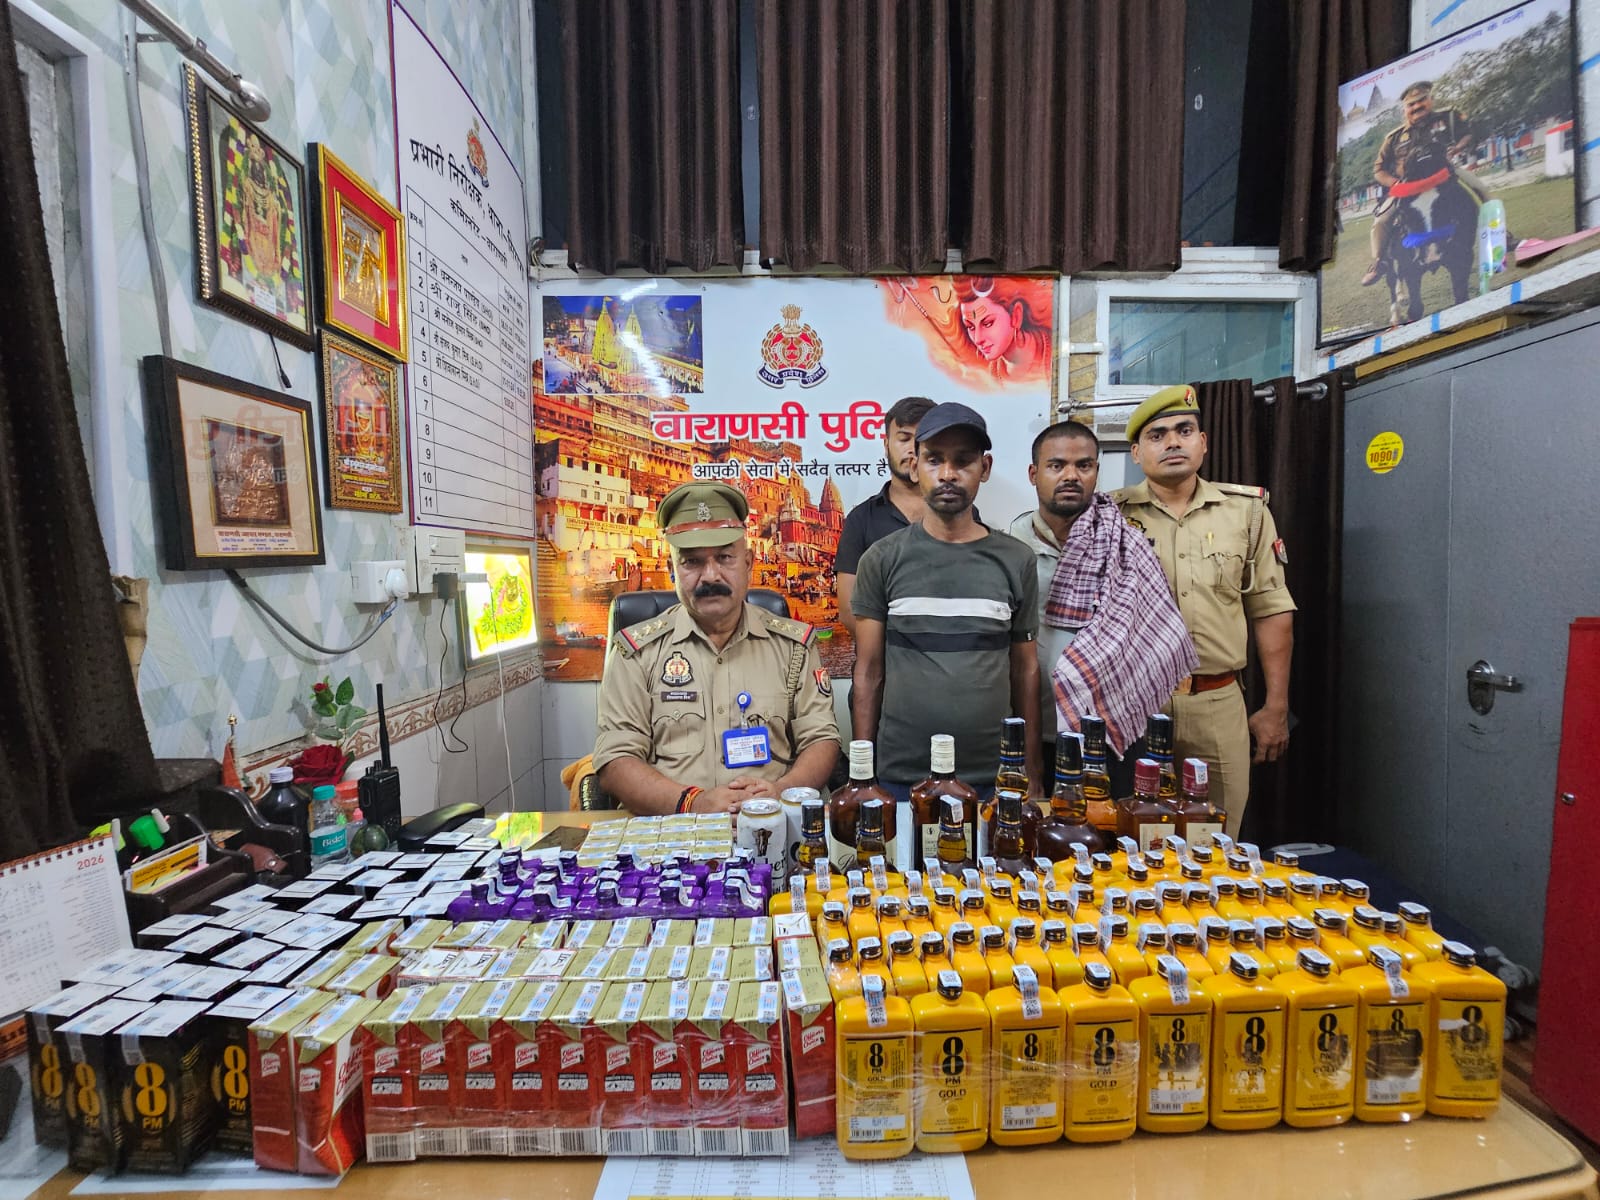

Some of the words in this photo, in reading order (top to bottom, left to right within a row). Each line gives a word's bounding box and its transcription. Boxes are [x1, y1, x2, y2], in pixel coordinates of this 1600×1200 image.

[410, 138, 444, 176] प्रभारी
[418, 276, 424, 289] 2
[419, 300, 425, 313] 3
[430, 282, 441, 300] श्री
[445, 292, 462, 318] राजू
[421, 325, 426, 337] 4
[422, 350, 427, 363] 5
[423, 375, 428, 387] 6
[424, 400, 429, 412] 7
[425, 424, 430, 436] 8
[653, 401, 809, 441] वाराणसी
[819, 400, 888, 453] पुलि
[426, 448, 431, 460] 9
[1369, 450, 1393, 463] 1090
[694, 458, 740, 478] आपकी
[746, 459, 773, 477] सेवा
[779, 458, 792, 477] में
[797, 458, 828, 477] सदैव
[835, 462, 870, 477] तत्पर
[422, 472, 432, 484] 10
[424, 496, 432, 508] 11
[77, 855, 104, 870] 2026
[1171, 1018, 1185, 1042] 8
[1461, 1005, 1483, 1044] 8
[1245, 1016, 1265, 1056] 8
[1317, 1013, 1338, 1052] 8
[1024, 1032, 1038, 1058] 8
[1094, 1027, 1115, 1066] 8
[869, 1043, 884, 1068] 8
[942, 1036, 964, 1076] 8
[40, 1043, 64, 1098] 8
[223, 1045, 249, 1099] 8
[945, 1076, 961, 1085] PM
[1090, 1080, 1117, 1089] GOLD
[74, 1062, 101, 1117] 8
[134, 1062, 168, 1117] 8
[939, 1089, 966, 1098] GOLD
[45, 1098, 60, 1110] PM
[228, 1099, 247, 1112] PM
[83, 1115, 100, 1129] PM
[142, 1116, 163, 1130] PM
